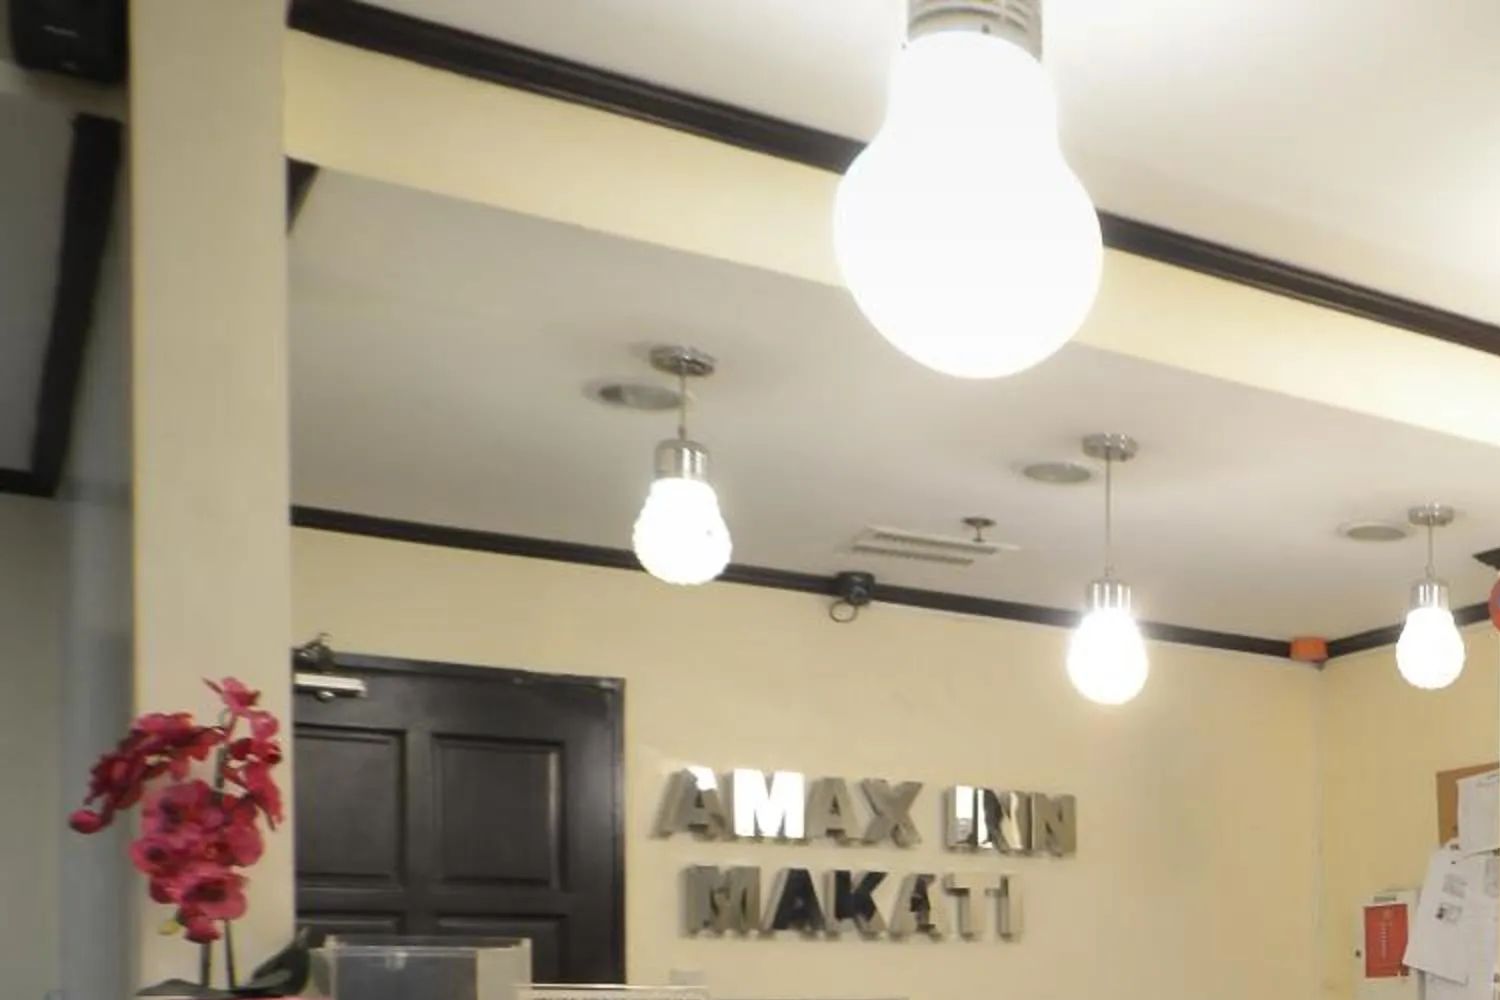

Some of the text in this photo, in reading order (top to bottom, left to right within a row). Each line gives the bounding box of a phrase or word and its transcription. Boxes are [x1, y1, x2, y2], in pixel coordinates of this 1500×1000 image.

[651, 765, 1077, 858] AMAX INN
[680, 865, 1023, 941] MAKATI
